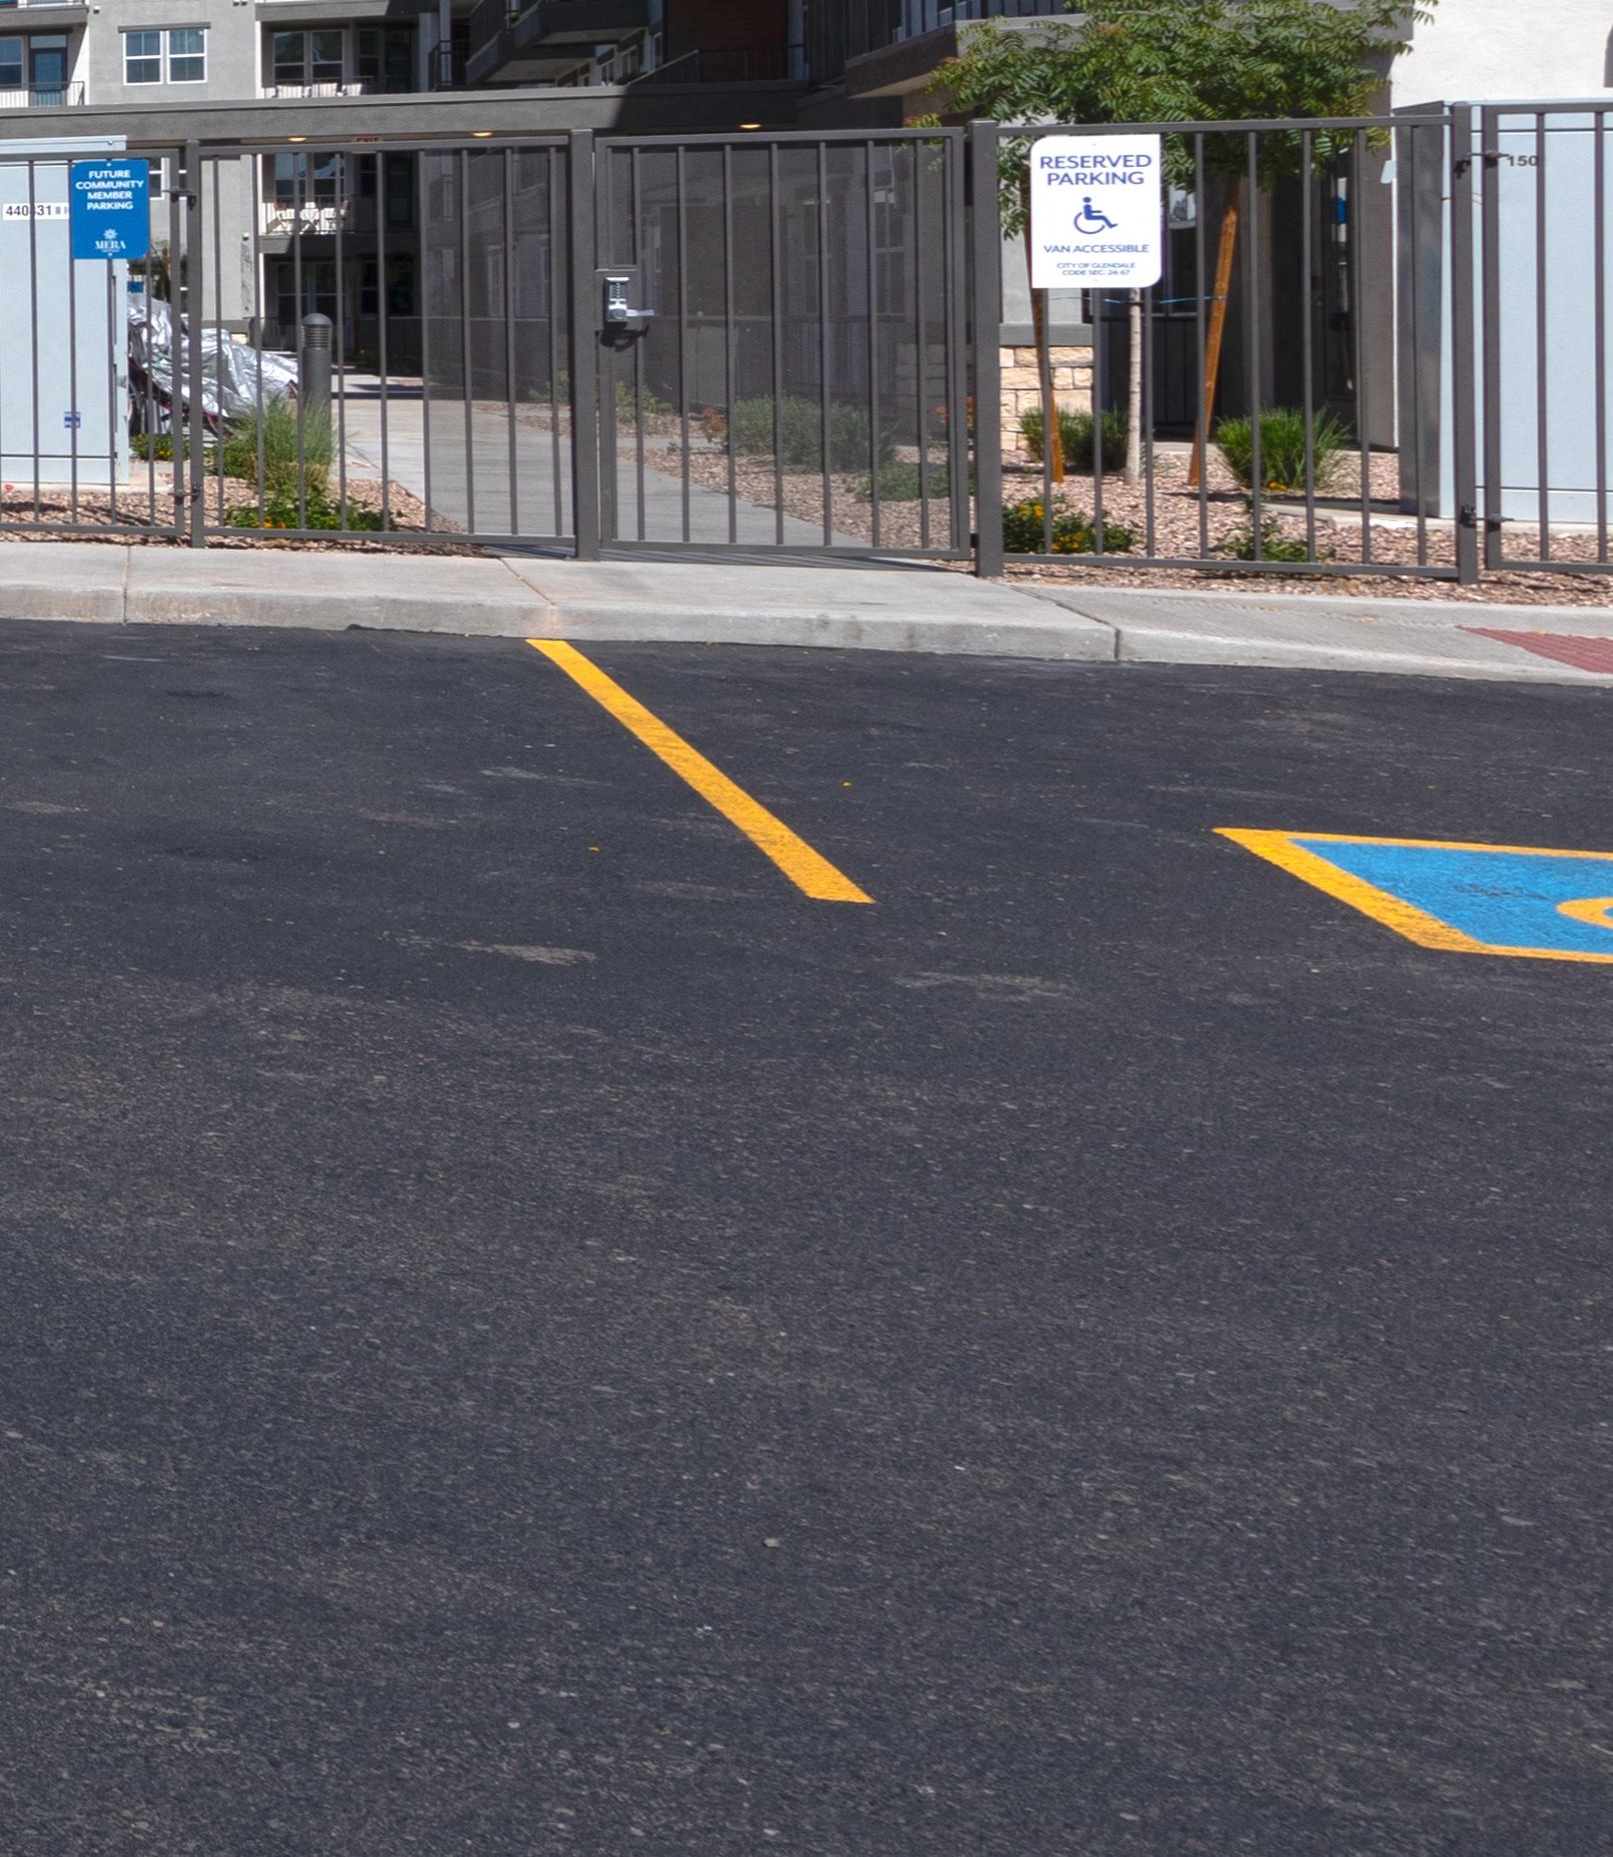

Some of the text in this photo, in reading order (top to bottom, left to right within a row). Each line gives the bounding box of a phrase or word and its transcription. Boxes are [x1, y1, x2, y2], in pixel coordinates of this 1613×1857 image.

[1040, 154, 1152, 169] RESERVED
[88, 170, 131, 179] FUTURE
[1047, 171, 1145, 186] PARKING
[75, 180, 144, 190] COMMUNITY
[87, 191, 133, 200] MEMBER
[5, 204, 52, 216] 44031
[87, 201, 134, 210] PARKING
[94, 239, 127, 250] MERA
[1043, 244, 1149, 253] VAN ACCESSIBLE
